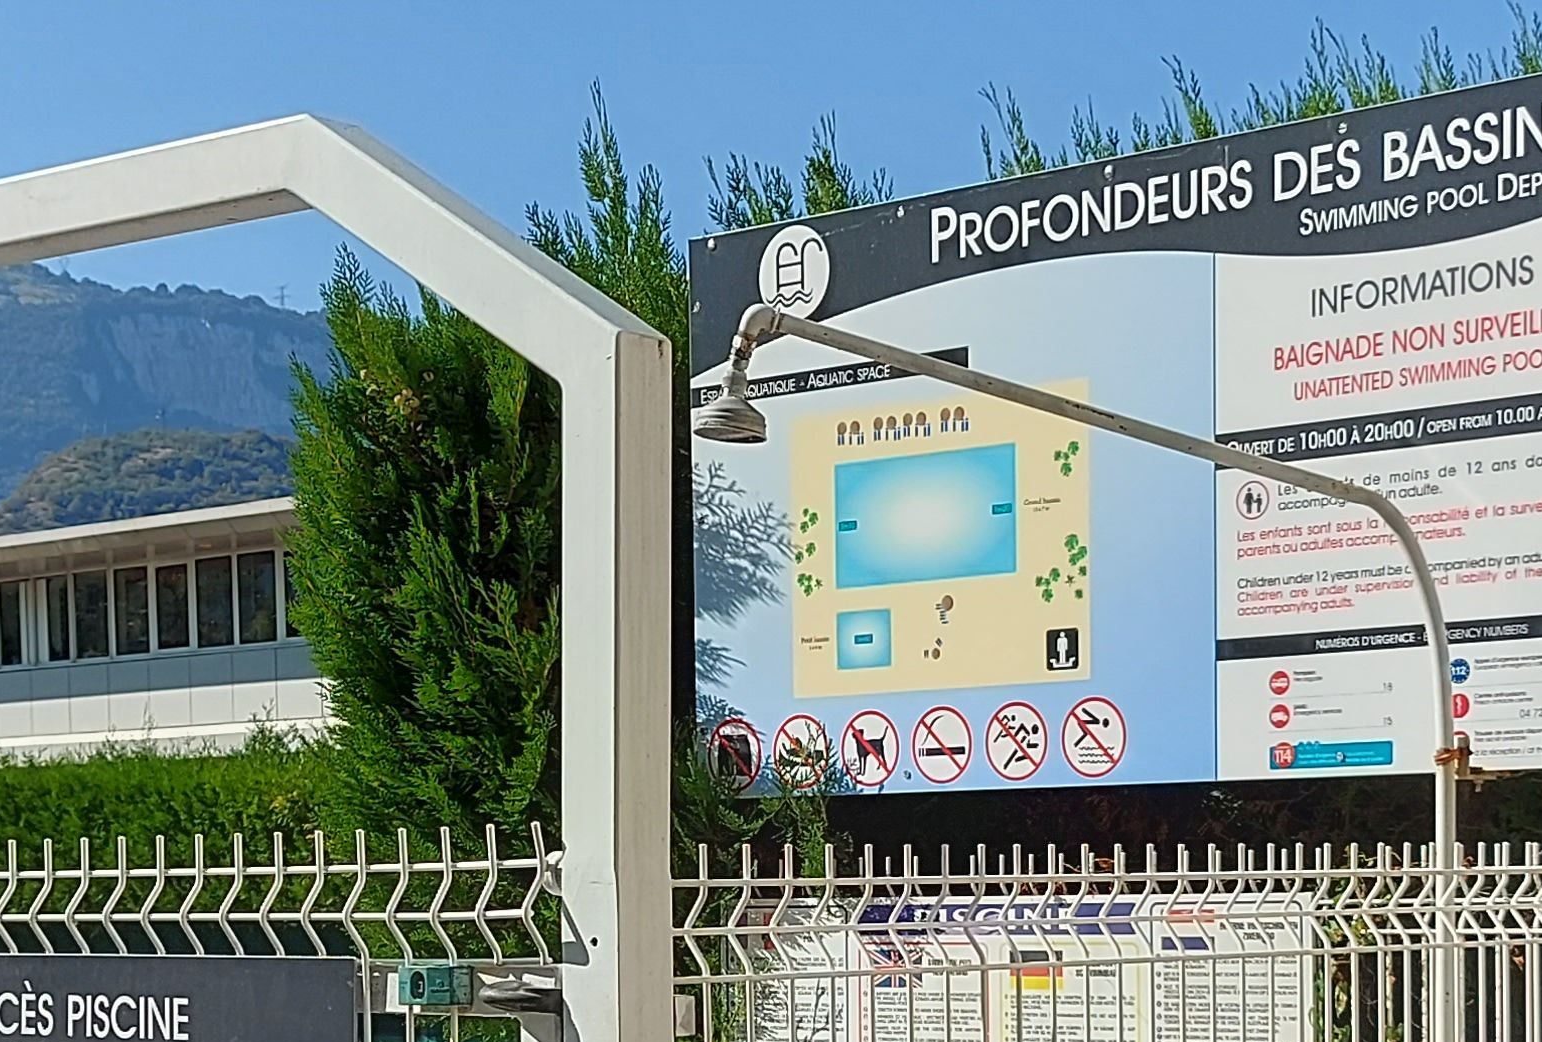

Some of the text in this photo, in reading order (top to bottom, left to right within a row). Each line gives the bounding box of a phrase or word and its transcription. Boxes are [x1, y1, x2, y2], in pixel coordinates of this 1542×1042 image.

[930, 159, 1254, 264] PROFONDEURS
[1273, 138, 1361, 202] DES
[1299, 195, 1419, 236] SWIMMING
[1427, 184, 1490, 214] POOL
[1311, 255, 1535, 318] INFORMATIONS
[1274, 331, 1385, 371] BAIGNADE
[1392, 323, 1445, 353] NON
[807, 369, 854, 390] AQUATIC
[857, 364, 891, 382] SPACE
[1293, 370, 1394, 401] UNATTENTED
[1399, 355, 1497, 387] SWIMMING
[1278, 437, 1295, 453] DE
[1350, 425, 1360, 445] À
[1426, 419, 1457, 435] OPEN
[1460, 414, 1493, 431] FROM
[1496, 405, 1535, 426] 10.00
[1278, 484, 1298, 497] Les
[1363, 473, 1381, 486] de
[1389, 468, 1430, 483] moins
[1438, 465, 1457, 479] de
[1466, 461, 1484, 475] 12
[1491, 459, 1517, 472] ans
[1399, 483, 1443, 498] adulte.
[1237, 529, 1256, 543] Les
[1259, 524, 1303, 540] enfants
[1307, 521, 1331, 536] sont
[1336, 520, 1362, 532] sous
[1366, 516, 1379, 529] la
[1475, 506, 1488, 518] et
[1493, 504, 1505, 517] la
[1237, 543, 1282, 560] parents
[1282, 542, 1298, 554] ou
[1301, 537, 1344, 552] adultes
[1237, 576, 1281, 590] Children
[1282, 571, 1314, 586] under
[1316, 570, 1329, 583] 12
[1330, 568, 1359, 583] years
[1360, 565, 1386, 578] must
[1387, 564, 1403, 575] be
[1487, 555, 1503, 568] by
[1504, 554, 1520, 565] an
[1237, 589, 1283, 603] Children
[1289, 588, 1309, 598] are
[1315, 584, 1348, 597] under
[1315, 624, 1529, 650] NUMÉROS D'URGENCE NUMBERS
[67, 994, 190, 1041] PISCINE
